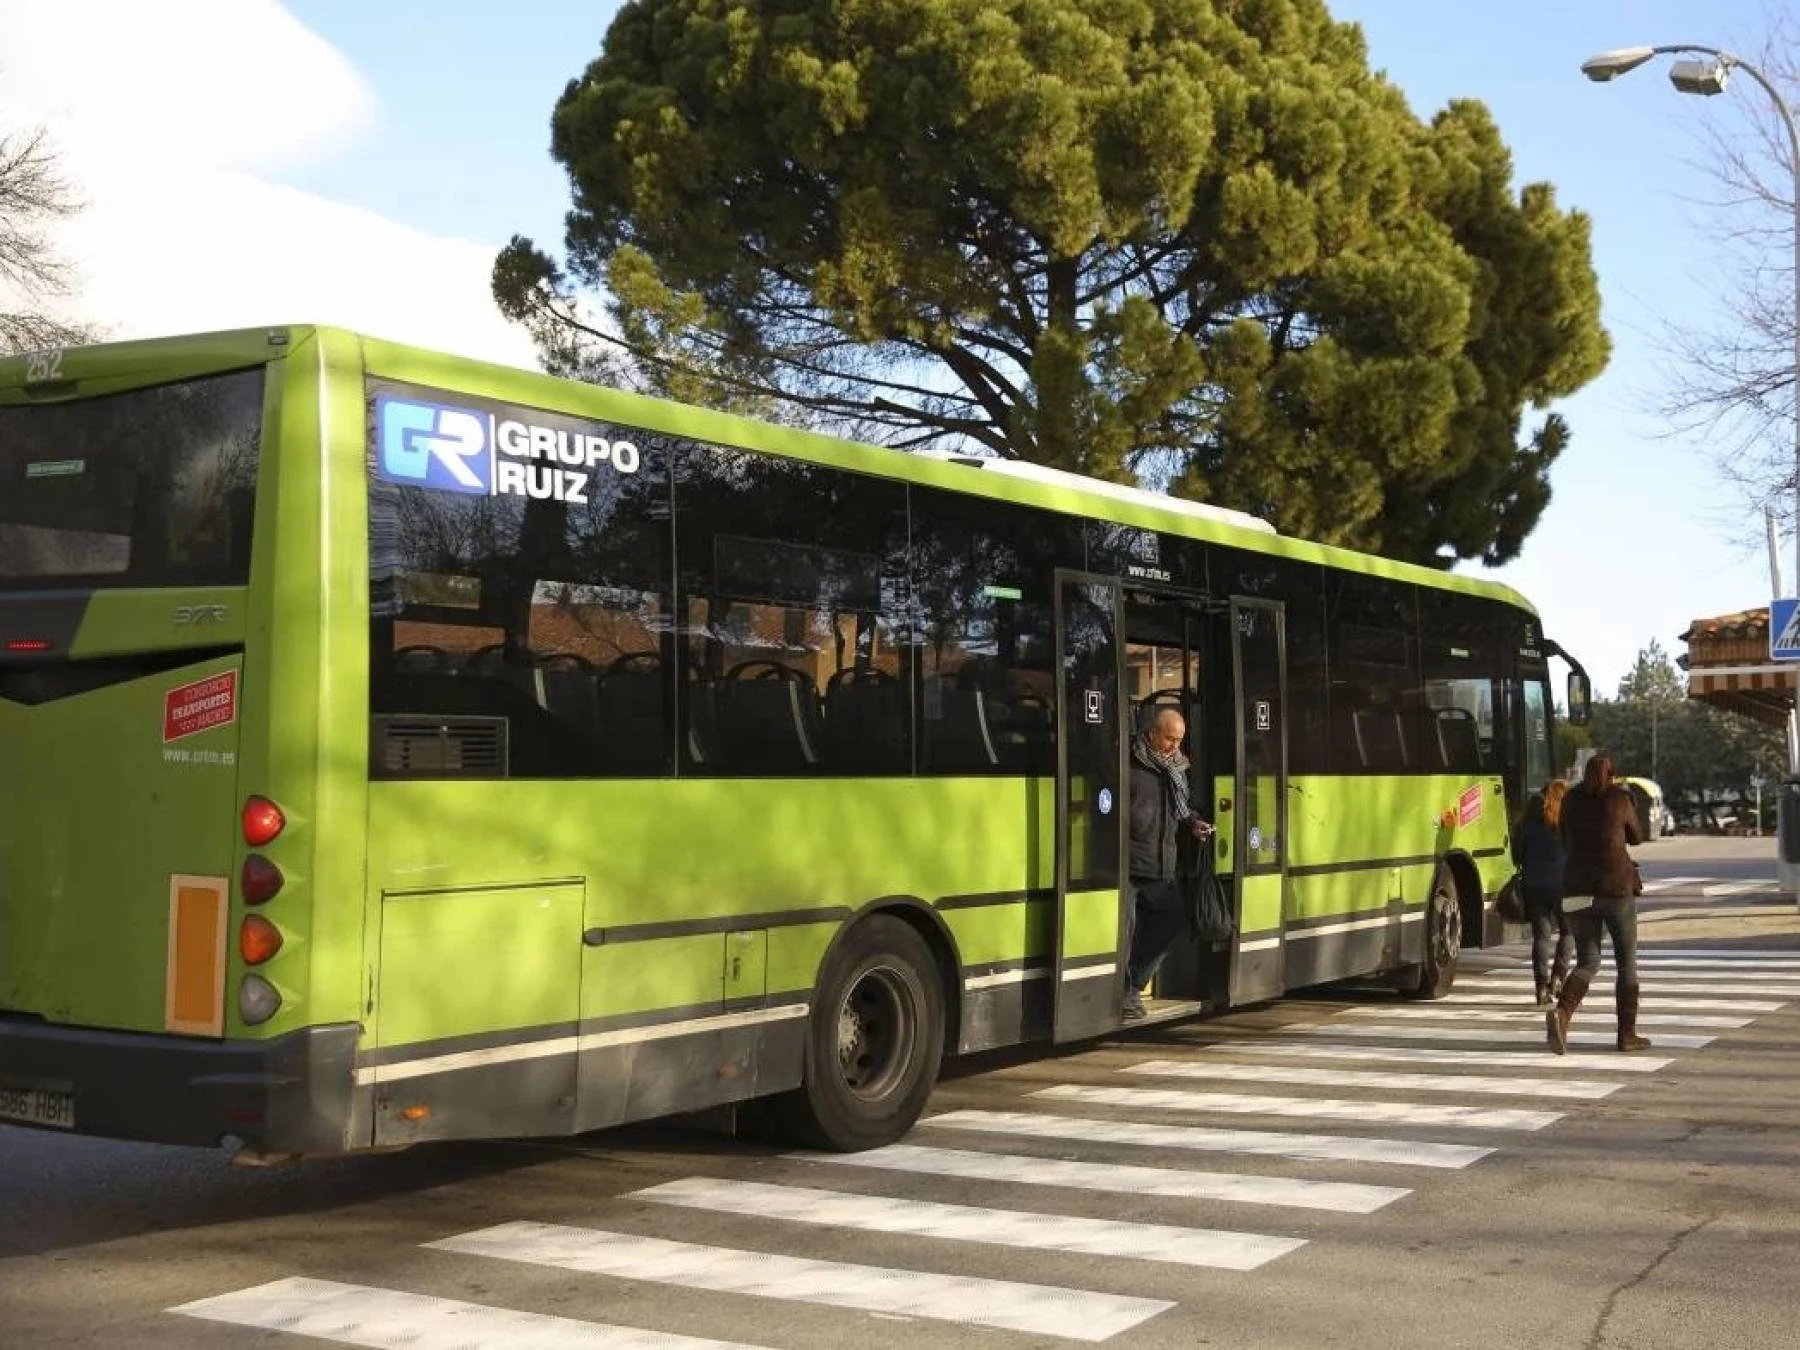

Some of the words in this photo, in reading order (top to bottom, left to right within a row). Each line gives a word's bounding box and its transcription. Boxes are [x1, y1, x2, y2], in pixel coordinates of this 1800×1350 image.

[27, 349, 62, 380] 252
[384, 400, 485, 489] GR
[497, 420, 640, 474] GRUPO
[499, 459, 588, 504] RUIZ
[172, 691, 231, 720] TRANSPORTES
